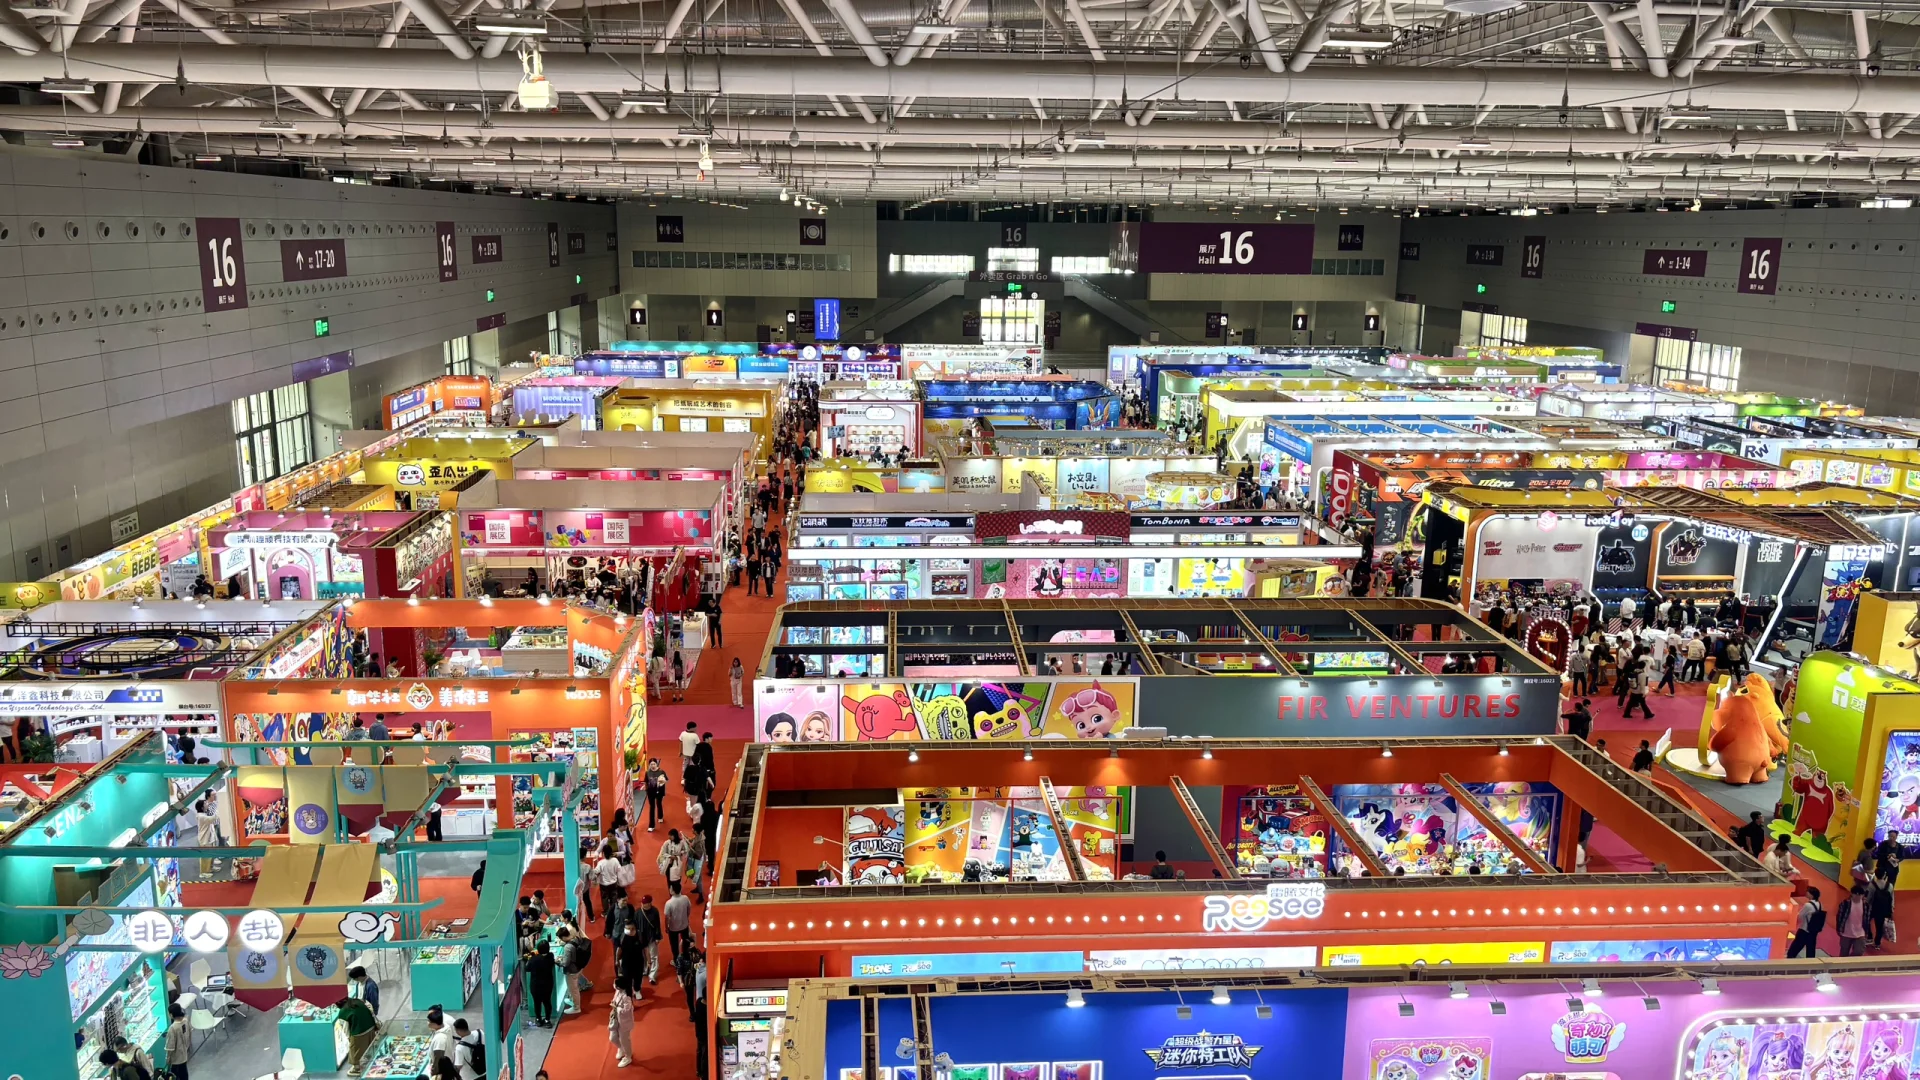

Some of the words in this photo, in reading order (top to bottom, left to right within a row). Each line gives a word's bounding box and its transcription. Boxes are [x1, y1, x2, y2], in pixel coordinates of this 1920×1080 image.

[1006, 227, 1022, 242] 16
[441, 234, 453, 266] 16
[550, 232, 558, 256] 16
[1199, 244, 1216, 254] 展厅
[1219, 231, 1255, 264] 16
[208, 237, 237, 287] 16
[315, 249, 335, 269] 17-20
[1199, 256, 1216, 264] Hall
[1526, 245, 1540, 268] 16
[1675, 257, 1690, 269] 1-14
[1748, 249, 1771, 280] 16
[979, 272, 1004, 281] 外卖区
[1006, 272, 1027, 280] Grab
[1036, 272, 1048, 280] Go
[488, 523, 507, 531] 国际
[606, 522, 625, 531] 国际
[1633, 528, 1647, 538] DC
[489, 532, 507, 540] 展区
[607, 532, 625, 540] 展区
[1758, 542, 1784, 553] JUSTICE
[1757, 551, 1782, 562] LEAGUE
[132, 553, 156, 578] BEBE
[1063, 567, 1119, 583] LEAD
[347, 688, 400, 705] 朝华社
[439, 687, 489, 706] 美猴王
[565, 690, 601, 700] 16D35
[1277, 695, 1328, 719] FIR
[1346, 694, 1521, 719] VENTURES
[1268, 785, 1297, 793] ALLSPARK
[134, 919, 280, 941] 非人哉
[1569, 1022, 1610, 1039] 奇妙!
[1174, 1036, 1233, 1046] 超级战警力量
[1570, 1038, 1606, 1056] 萌可
[1162, 1046, 1249, 1065] 迷你特工队
